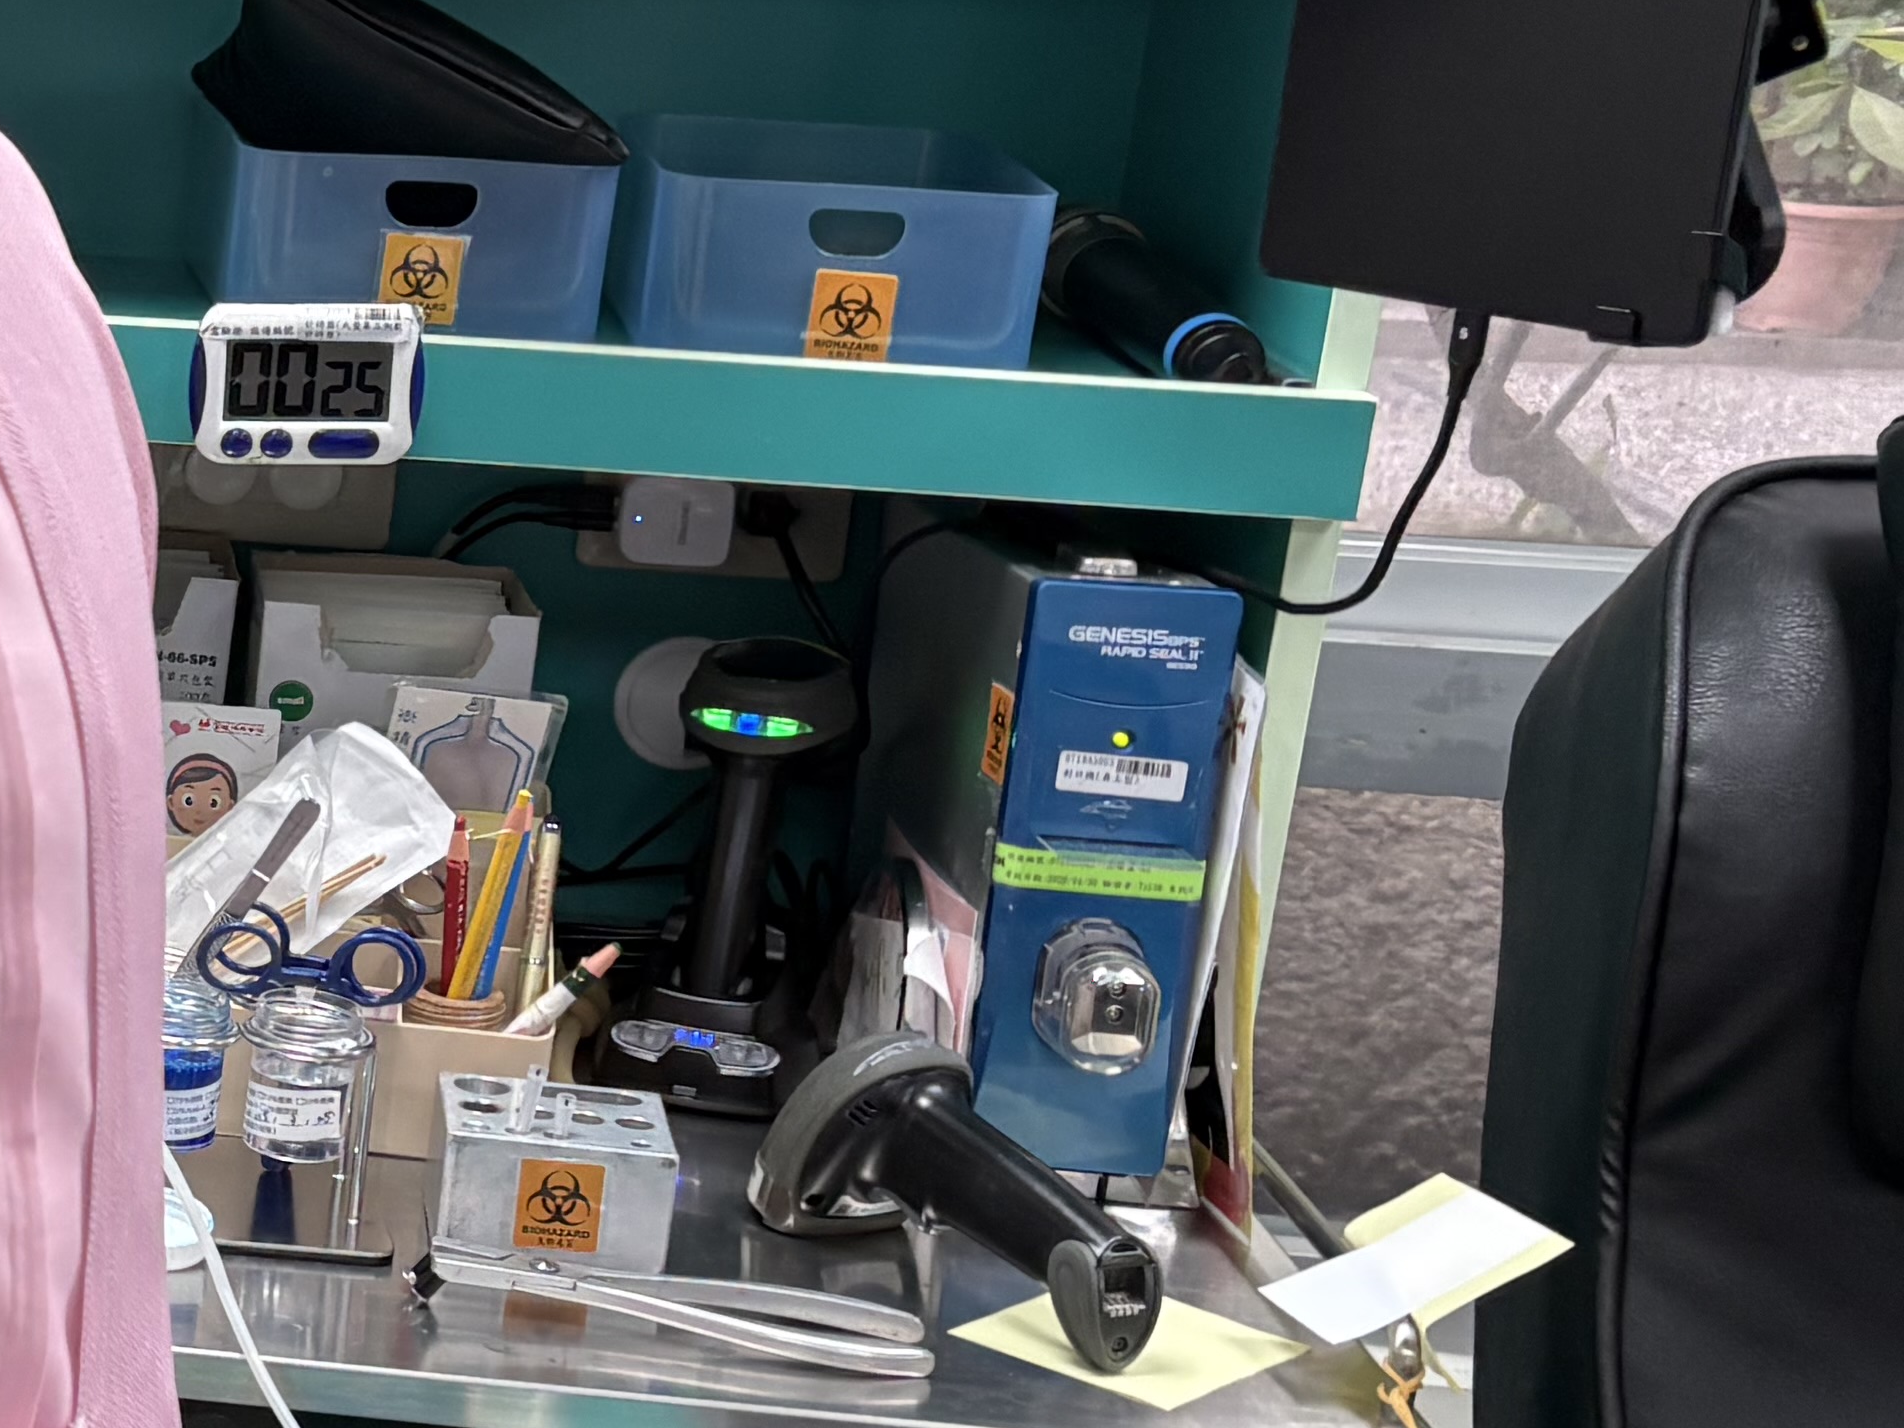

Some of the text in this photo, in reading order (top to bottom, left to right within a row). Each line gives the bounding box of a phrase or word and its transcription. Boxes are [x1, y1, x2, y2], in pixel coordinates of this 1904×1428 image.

[813, 338, 879, 352] BIOHAZARD
[1099, 645, 1147, 658] RAPID
[1149, 647, 1187, 661] SEAL
[521, 1224, 591, 1239] BIOHAZARD
